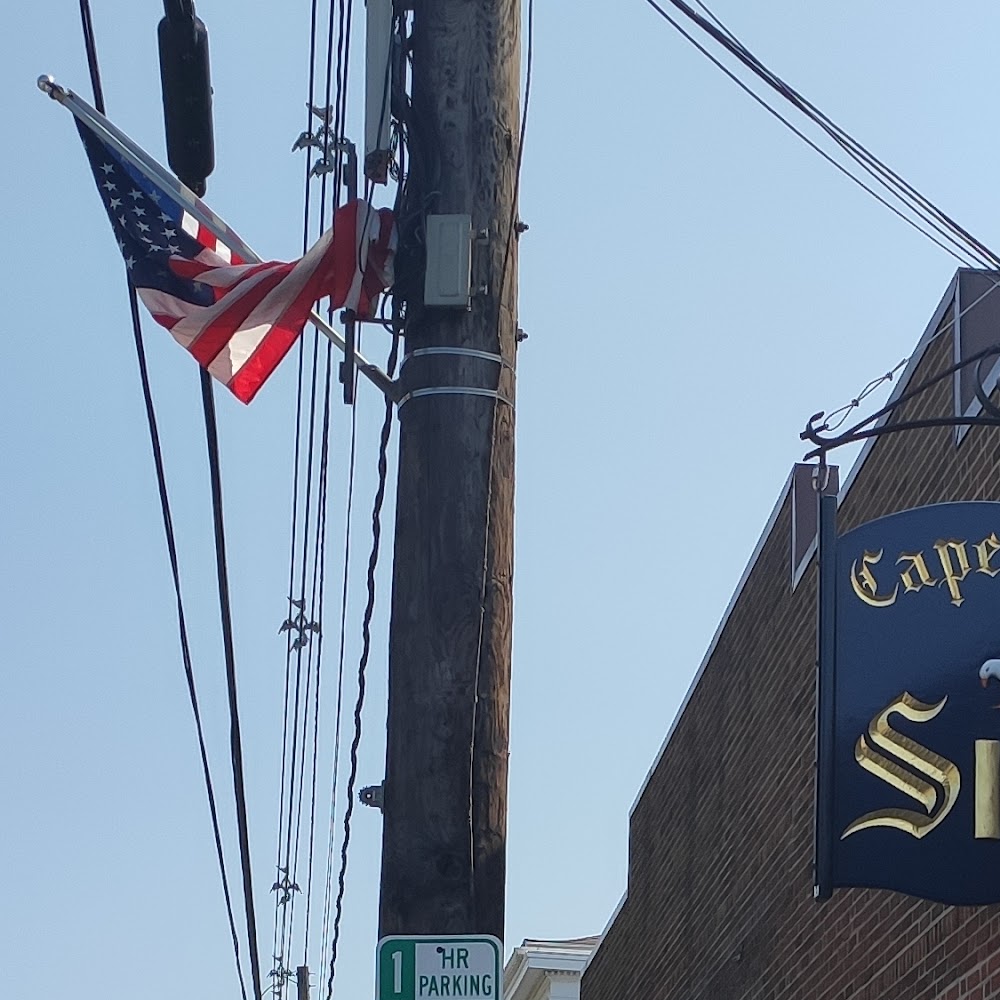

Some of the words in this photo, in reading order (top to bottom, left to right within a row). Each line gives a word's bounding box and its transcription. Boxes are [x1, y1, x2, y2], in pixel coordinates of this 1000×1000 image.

[391, 950, 402, 994] 1
[441, 947, 470, 970] HR
[419, 974, 492, 997] PARKING
